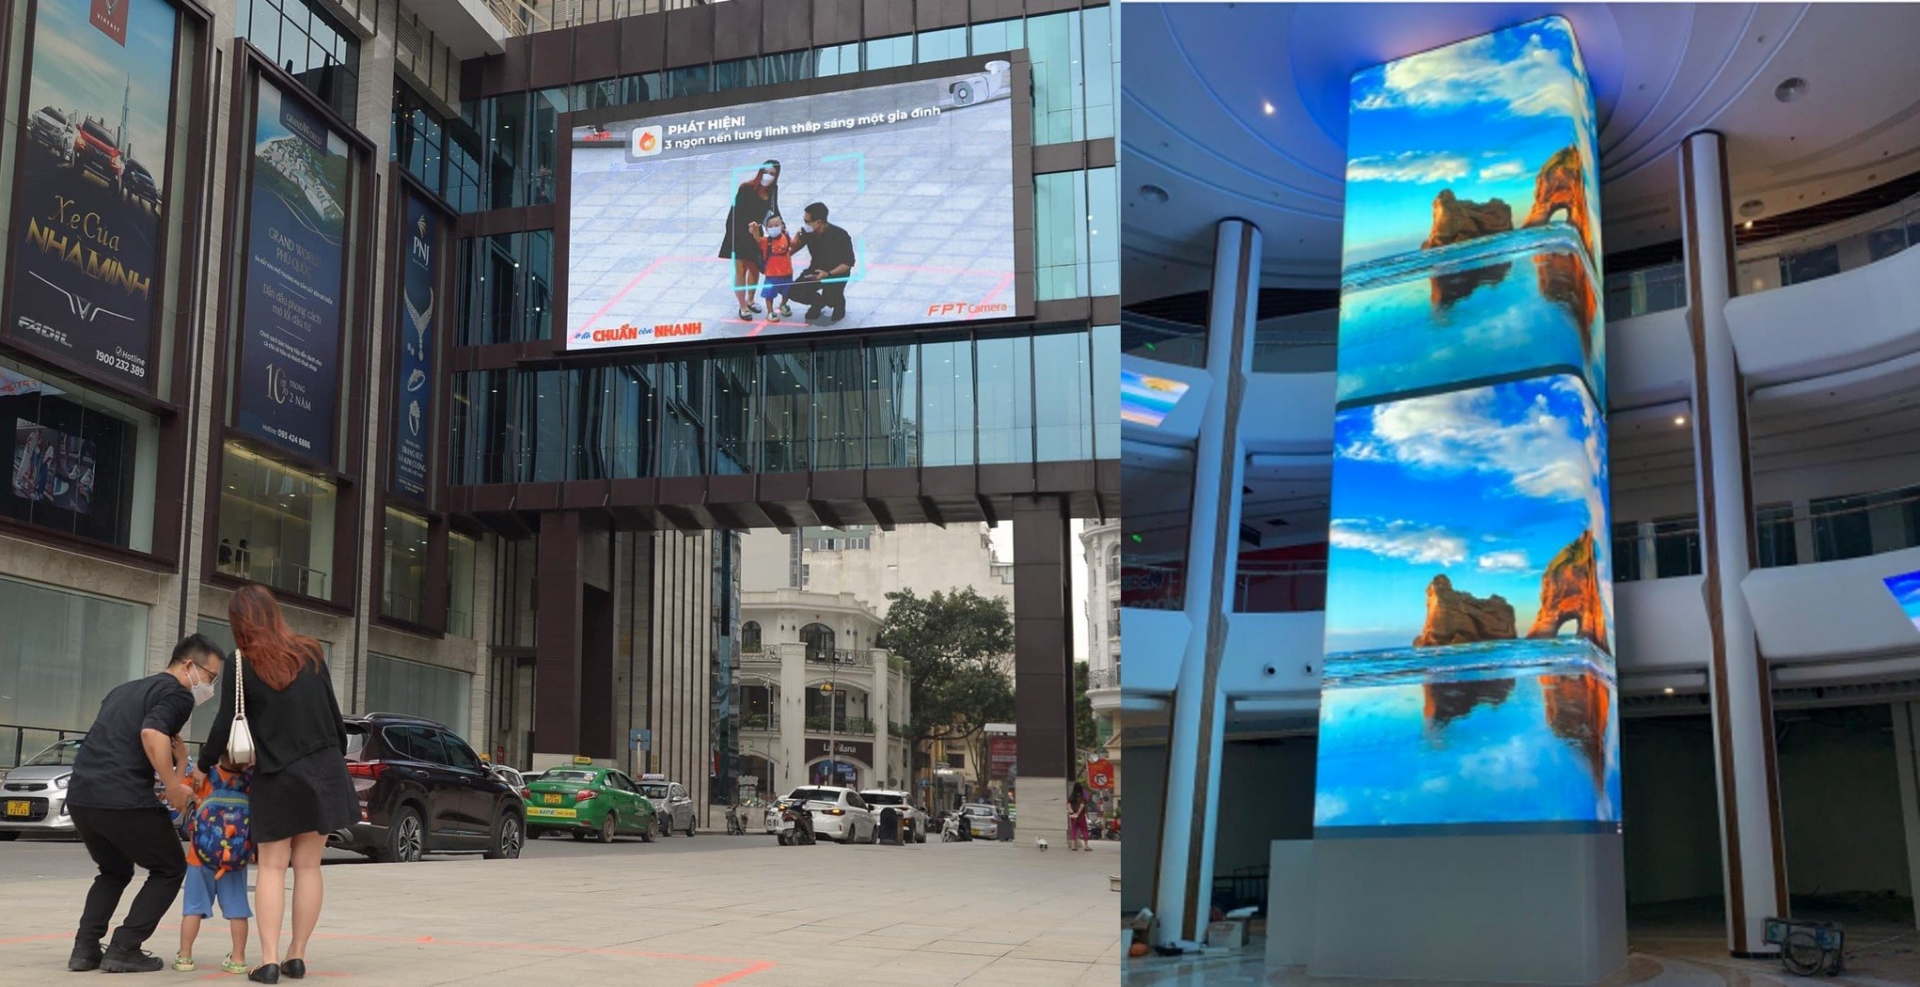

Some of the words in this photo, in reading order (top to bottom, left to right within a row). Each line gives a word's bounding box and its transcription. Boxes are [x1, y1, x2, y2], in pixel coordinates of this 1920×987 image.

[664, 139, 672, 149] 3
[675, 137, 708, 150] ngọn
[709, 131, 732, 145] nến
[734, 128, 762, 142] lung
[765, 124, 789, 137] linh
[823, 117, 855, 130] sáng
[858, 112, 885, 126] một
[888, 109, 908, 124] gia
[910, 106, 941, 119] đình
[668, 121, 705, 135] PHÁT
[708, 116, 746, 131] HIỆN!
[48, 194, 81, 230] Xe
[268, 227, 295, 251] GRAND
[413, 235, 430, 266] PNJ
[25, 216, 85, 275] NHÀ
[86, 248, 151, 302] MÌNH
[928, 302, 967, 316] FPT
[967, 303, 1007, 314] Camera
[17, 316, 73, 348] FADIL
[593, 323, 637, 342] CHUẨN
[654, 322, 702, 338] NHANH
[96, 349, 115, 366] 1900
[115, 358, 130, 372] 232
[130, 363, 145, 377] 389
[122, 350, 146, 366] Hotline
[289, 392, 294, 403] 2
[277, 428, 288, 440] 093
[288, 434, 298, 444] 424
